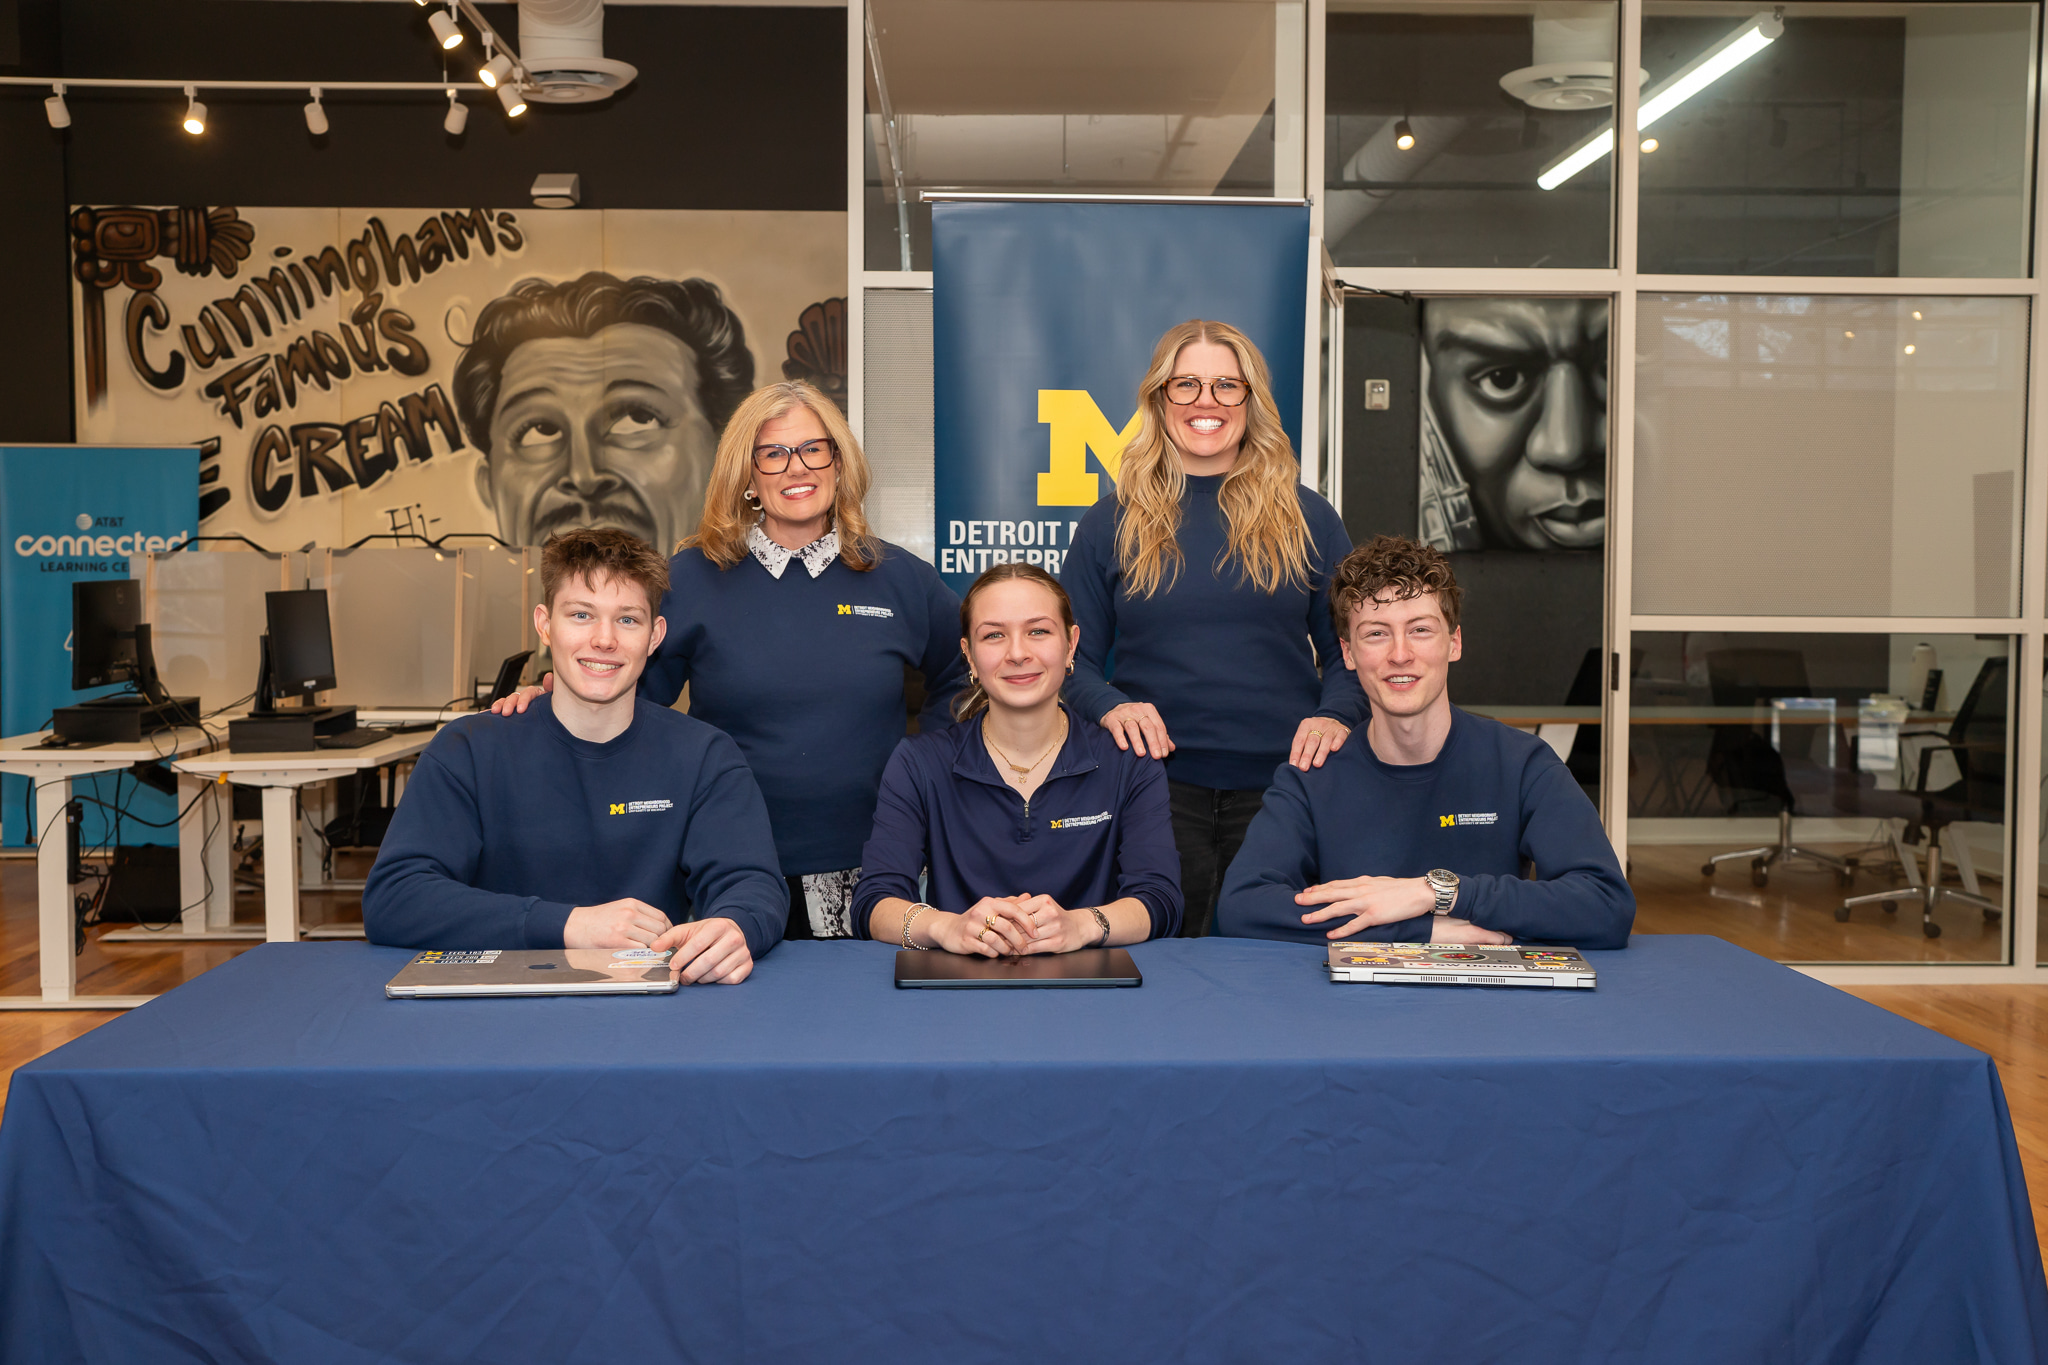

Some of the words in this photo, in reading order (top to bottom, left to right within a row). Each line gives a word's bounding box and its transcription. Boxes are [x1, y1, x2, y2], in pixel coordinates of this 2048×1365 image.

[125, 206, 524, 390] Cunningham's
[204, 308, 430, 430] Famous
[251, 382, 466, 512] CREAM
[94, 516, 124, 528] AT&T
[949, 520, 1062, 546] DETROIT
[14, 530, 188, 557] connected
[40, 561, 108, 573] LEARNING
[837, 604, 852, 615] M
[609, 803, 626, 815] M
[1439, 814, 1455, 827] M
